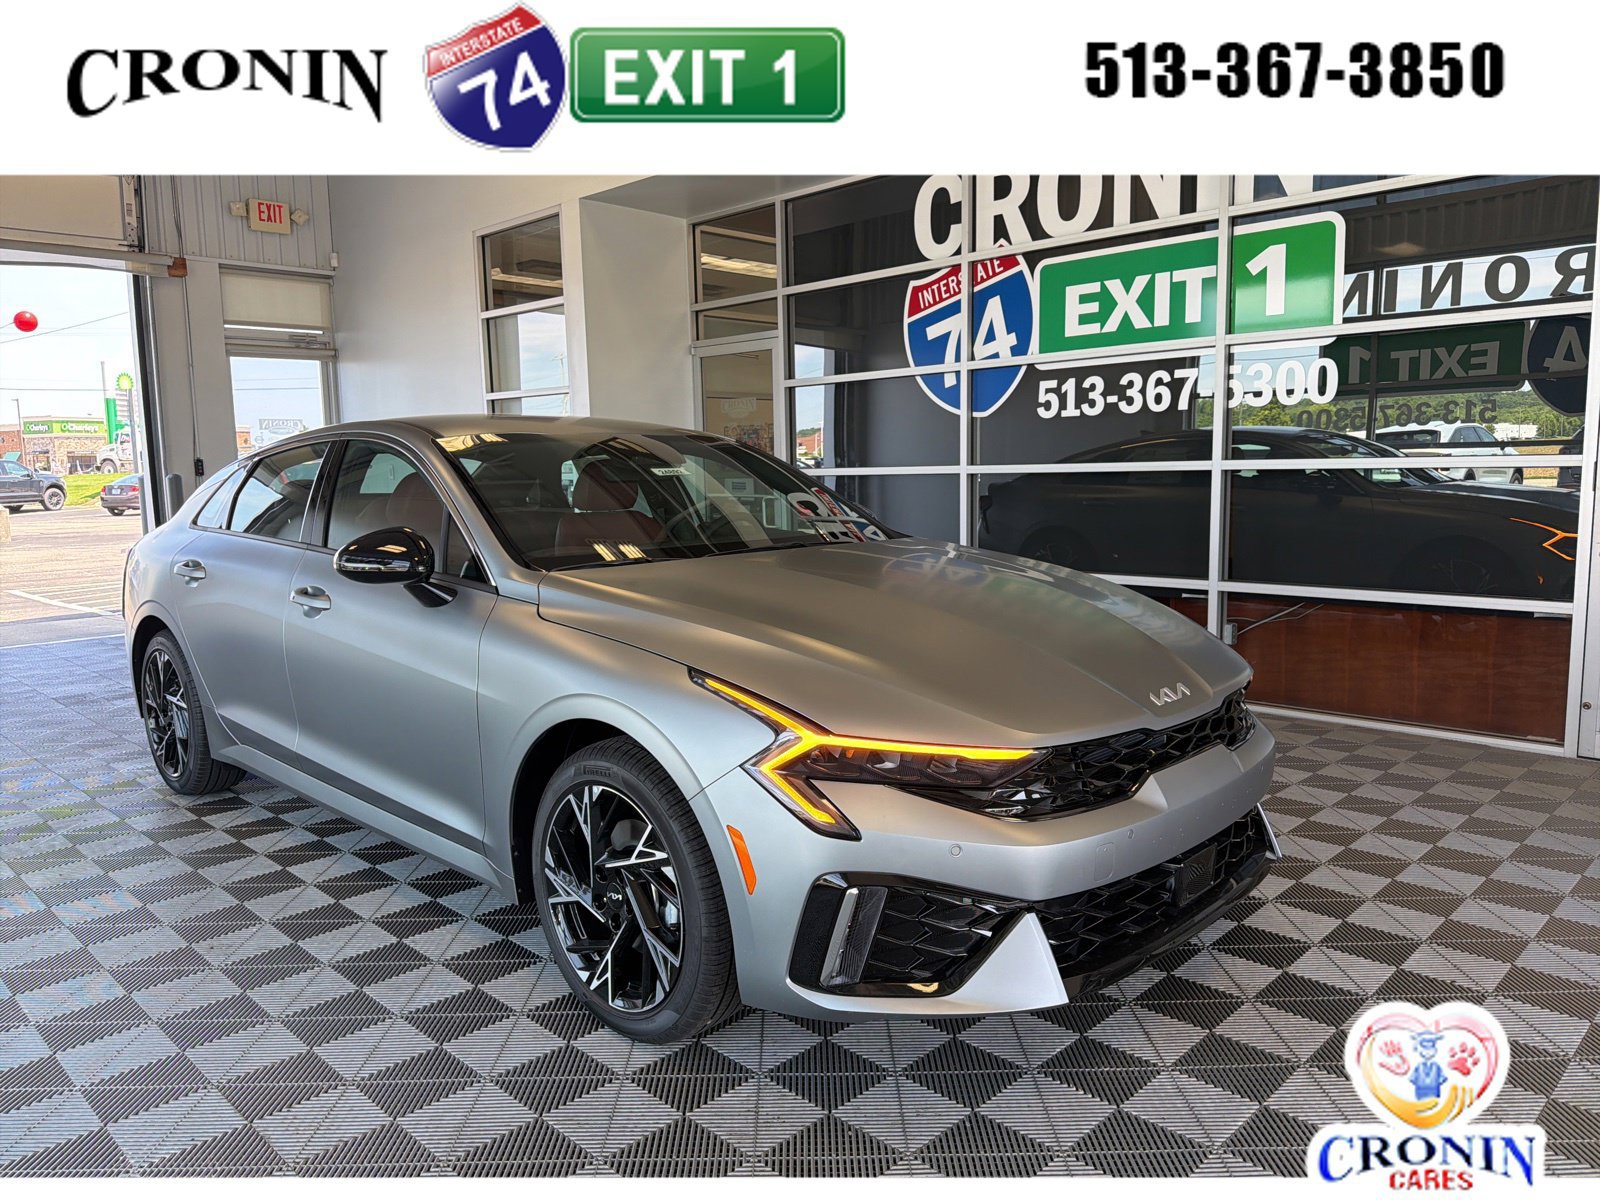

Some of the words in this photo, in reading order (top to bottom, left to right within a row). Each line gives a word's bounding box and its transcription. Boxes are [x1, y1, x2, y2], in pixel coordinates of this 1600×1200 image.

[257, 201, 284, 224] EXIT
[914, 174, 1313, 260] CRON
[918, 258, 1004, 309] INTERATE
[1064, 264, 1217, 337] EXIT
[1245, 243, 1287, 316] 1
[925, 294, 1017, 388] 74
[1036, 358, 1339, 418] 513-367-5300
